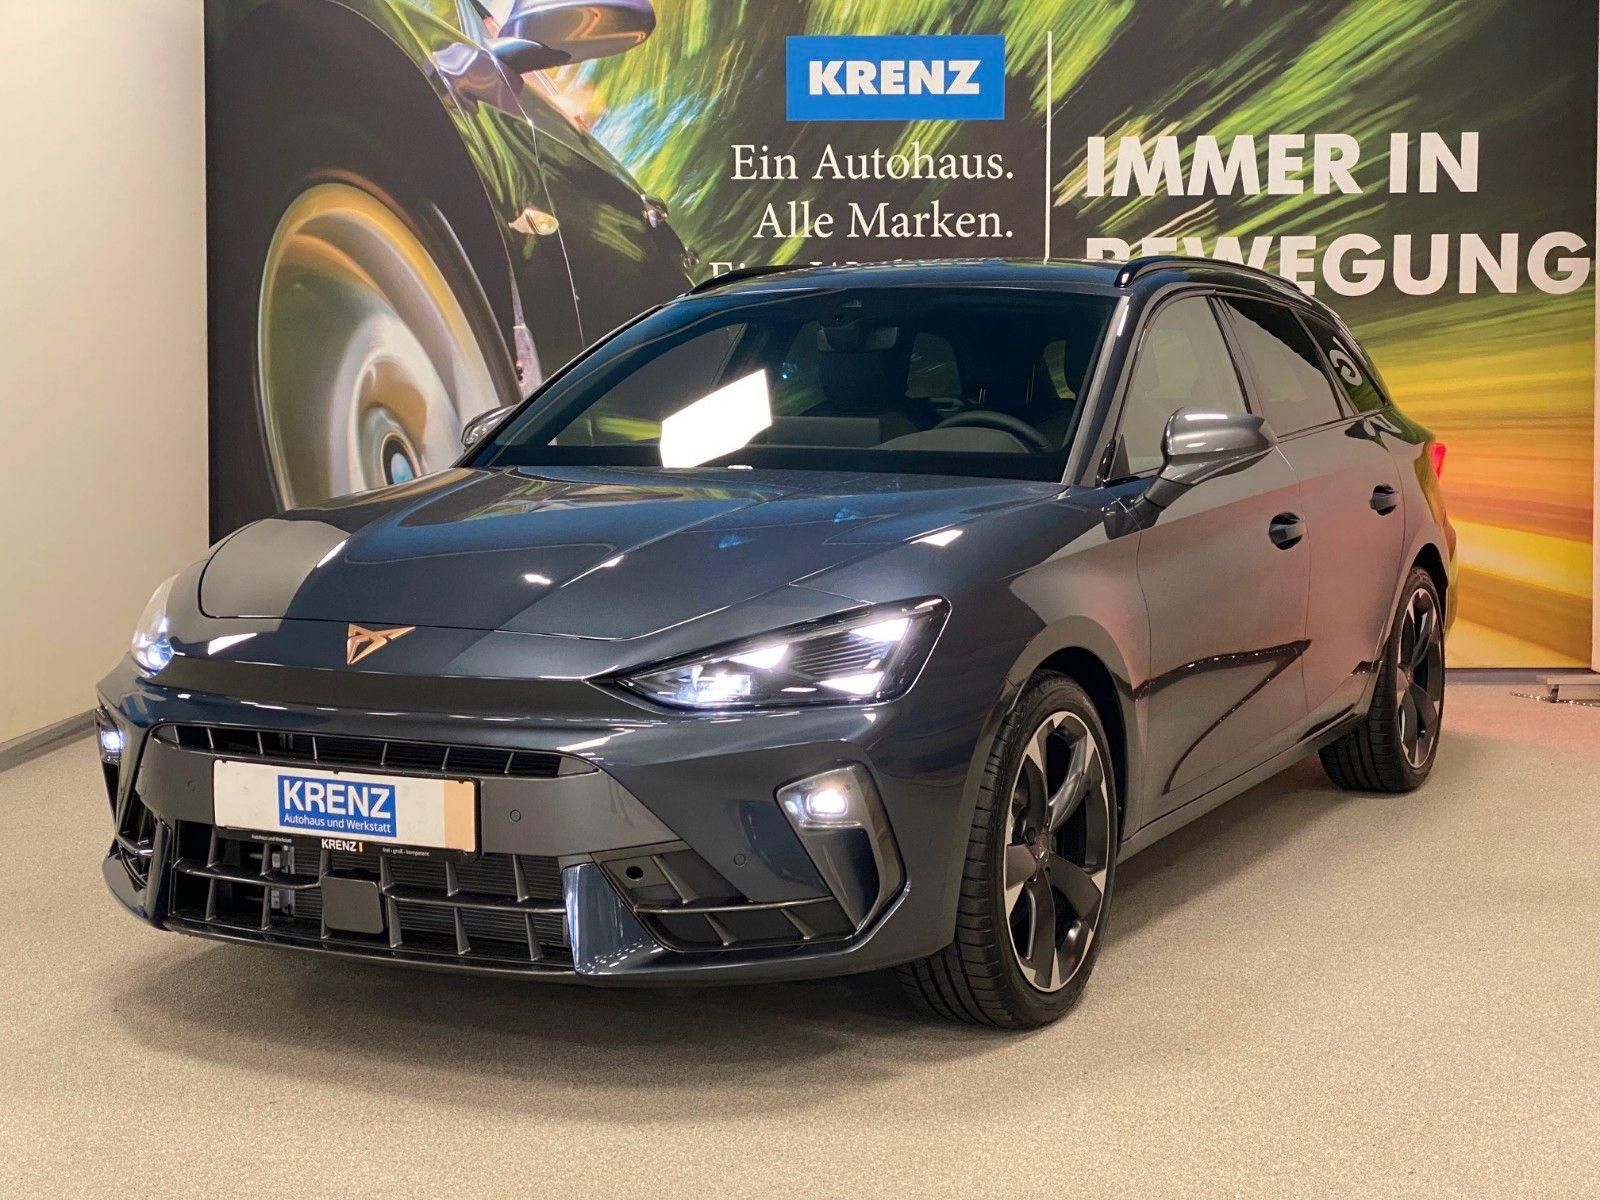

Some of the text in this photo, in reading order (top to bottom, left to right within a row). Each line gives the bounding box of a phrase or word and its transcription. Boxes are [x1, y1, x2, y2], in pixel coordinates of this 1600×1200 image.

[808, 60, 982, 96] KRENZ
[730, 141, 1014, 181] Ein Autohaus.
[1086, 131, 1480, 198] IMMER IN
[752, 200, 1014, 239] Alle Marken.
[283, 779, 391, 819] KRENZ
[284, 813, 392, 833] Autohaus und Werkstatt
[321, 838, 357, 852] KRENZ
